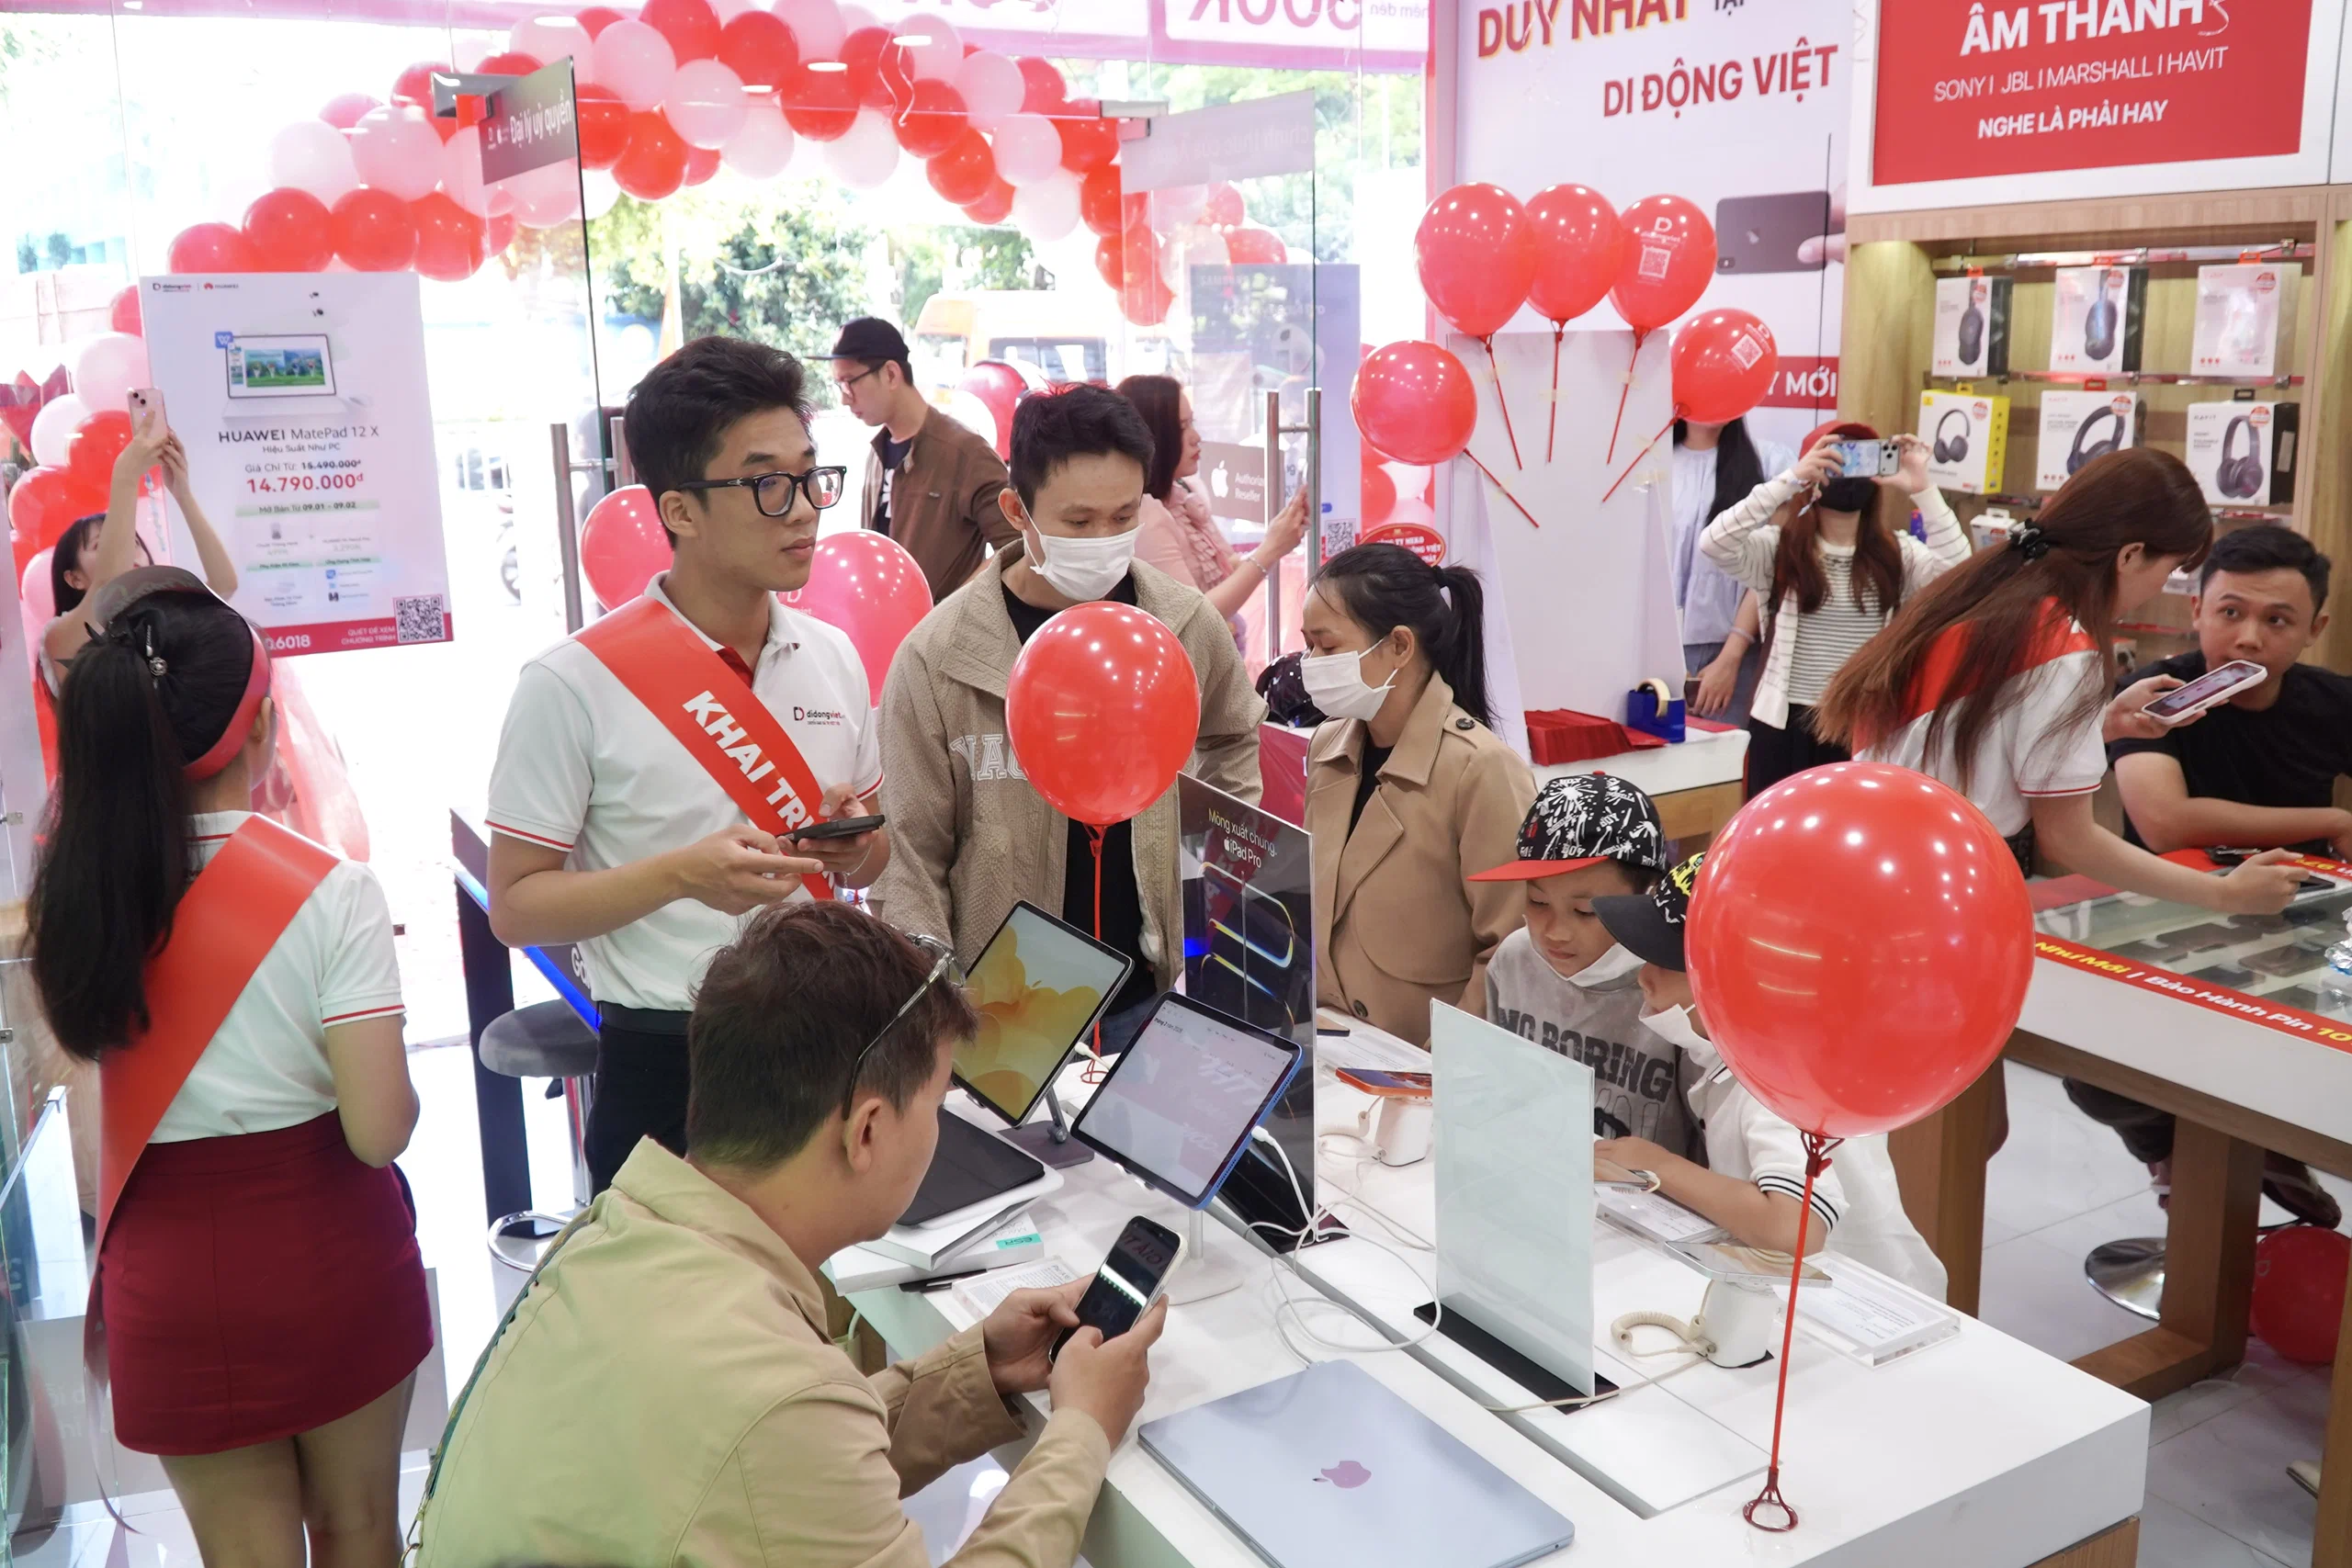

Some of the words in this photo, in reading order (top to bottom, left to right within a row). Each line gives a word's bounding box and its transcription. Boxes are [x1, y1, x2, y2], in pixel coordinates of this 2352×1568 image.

[1959, 3, 2029, 56] ÂM
[2038, 0, 2204, 43] THANH
[1604, 78, 1634, 118] DI
[1642, 57, 1743, 118] ĐỘNG
[1752, 37, 1838, 103] VIỆT
[1934, 73, 1984, 102] SONY
[2001, 70, 2034, 95] JBL
[2046, 57, 2154, 88] MARSHALL
[2166, 46, 2229, 73] HAVIT
[1977, 113, 2035, 139] NGHE
[2038, 105, 2064, 133] LÀ
[2068, 98, 2119, 130] PHẢI
[2121, 98, 2169, 125] HAY
[1785, 365, 1838, 398] MỚI
[219, 429, 286, 443] HUAWEI
[290, 426, 347, 440] MatePad
[352, 425, 367, 437] 12
[371, 425, 379, 437] X
[329, 443, 341, 451] PC
[302, 503, 325, 512] 09.01
[334, 502, 356, 510] 09.02
[682, 690, 775, 783] KHAI
[1230, 840, 1247, 862] iPad
[1249, 849, 1261, 869] Pro
[2196, 990, 2267, 1018] Hành
[2267, 1011, 2313, 1032] Pin
[2316, 1027, 2352, 1049] 10
[1541, 1021, 1675, 1103] BORING
